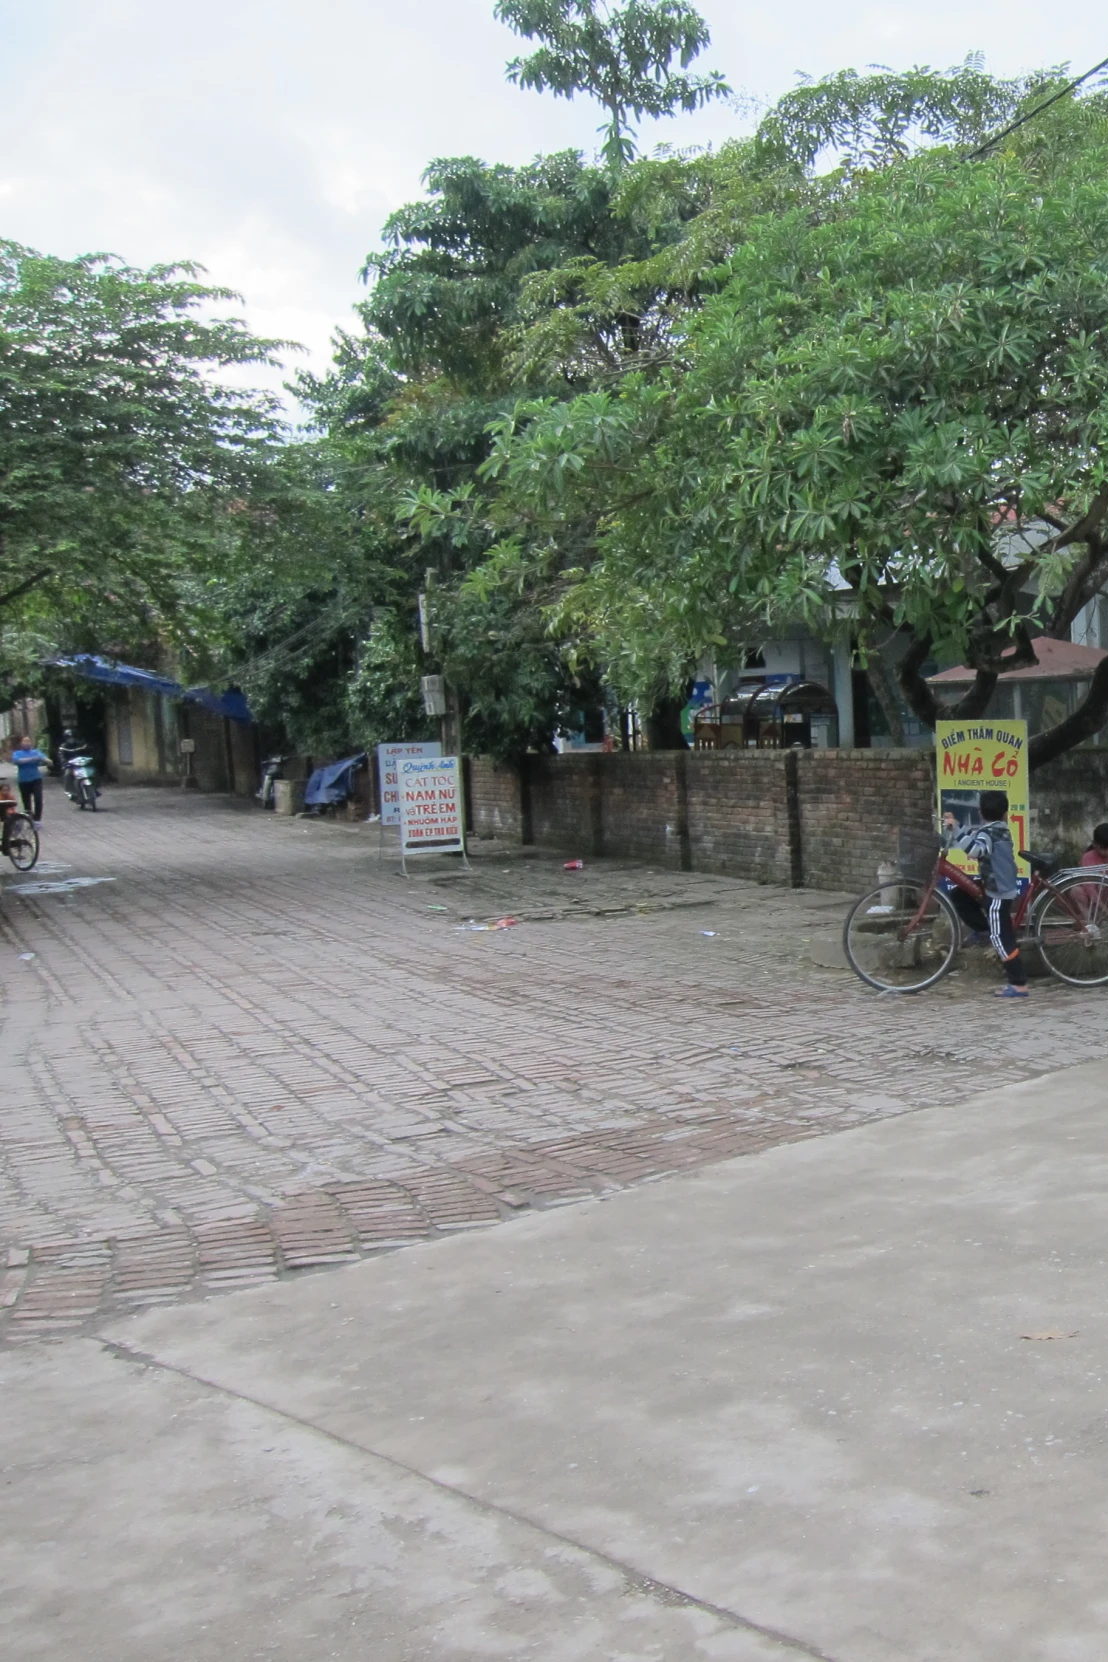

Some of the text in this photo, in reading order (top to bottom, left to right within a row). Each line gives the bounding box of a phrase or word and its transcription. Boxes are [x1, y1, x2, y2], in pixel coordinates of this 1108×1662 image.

[967, 725, 994, 740] THĂM
[996, 729, 1024, 750] QUAN
[943, 746, 1020, 778] NHÀ CỔ
[439, 803, 456, 813] EM
